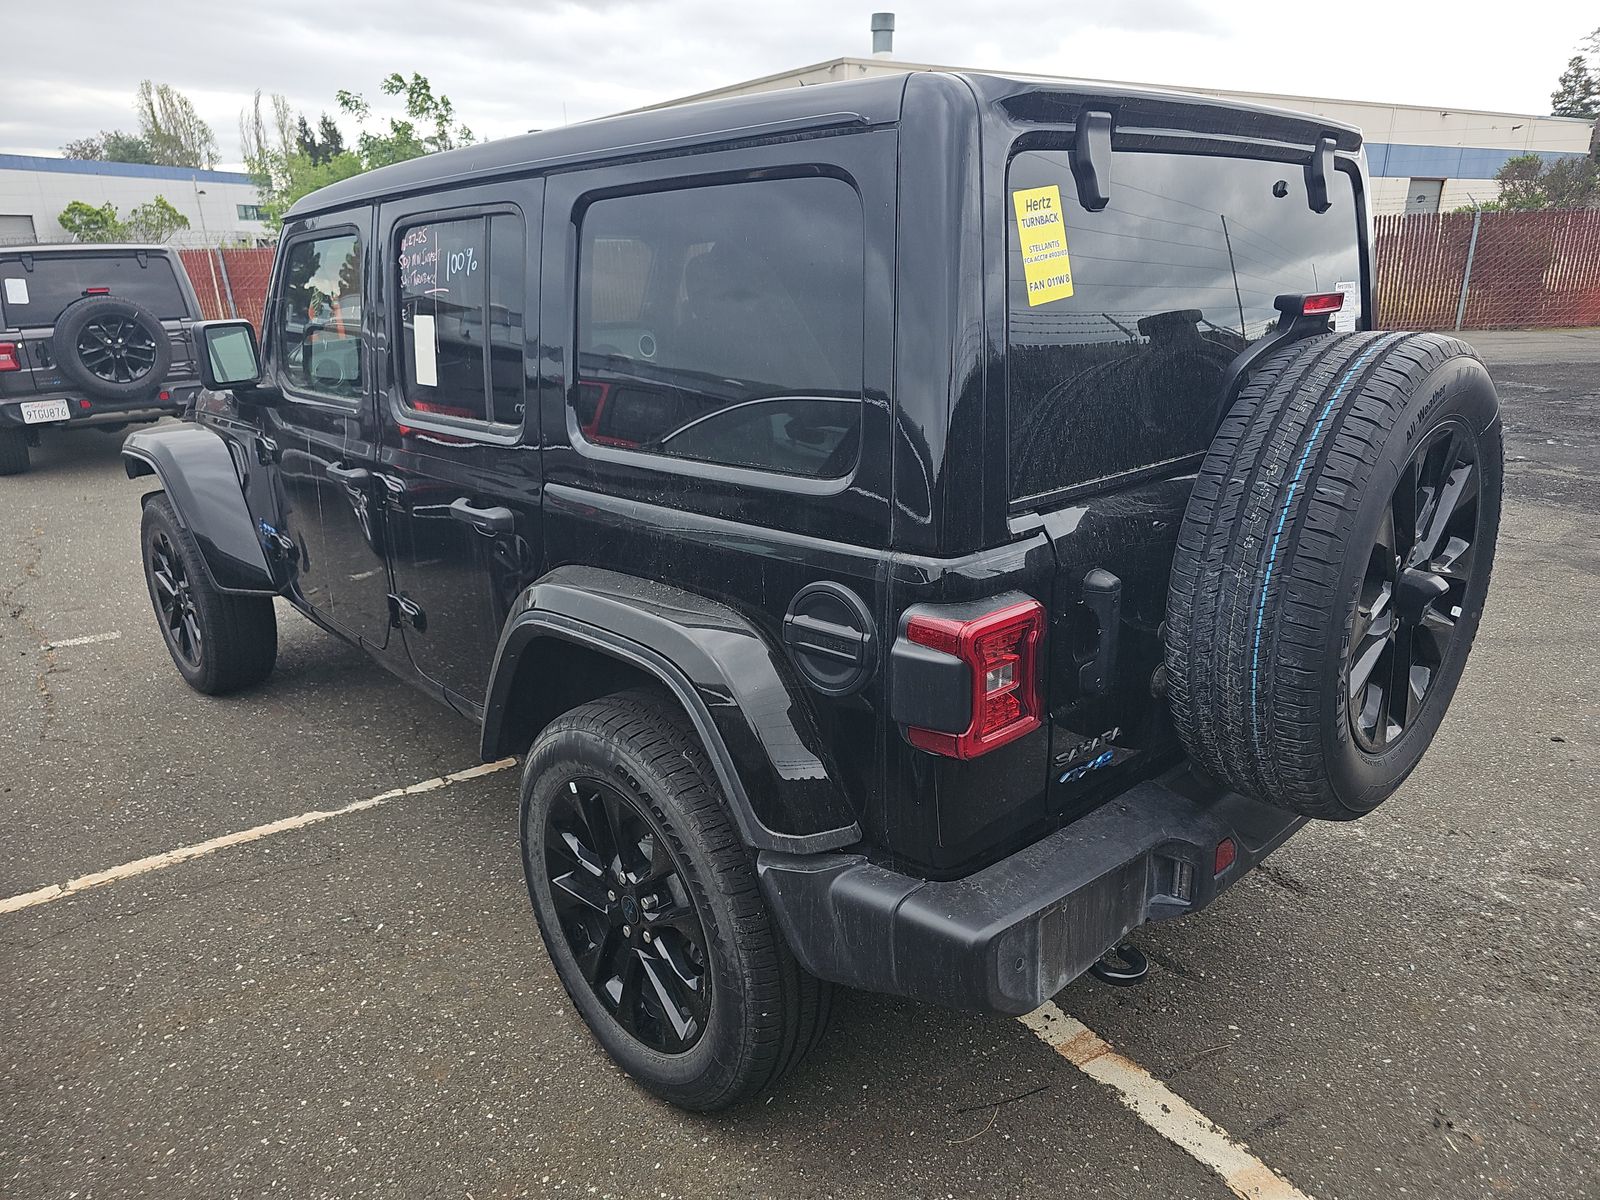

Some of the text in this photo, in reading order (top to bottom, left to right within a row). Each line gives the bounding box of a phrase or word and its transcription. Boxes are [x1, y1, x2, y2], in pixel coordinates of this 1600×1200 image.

[1026, 197, 1051, 212] Hertz
[1021, 213, 1059, 228] TURNBACK
[1029, 240, 1059, 253] STELLANTIS
[446, 247, 478, 282] 100%
[1029, 273, 1070, 292] FAN 011W8
[1406, 383, 1446, 445] All-Weather
